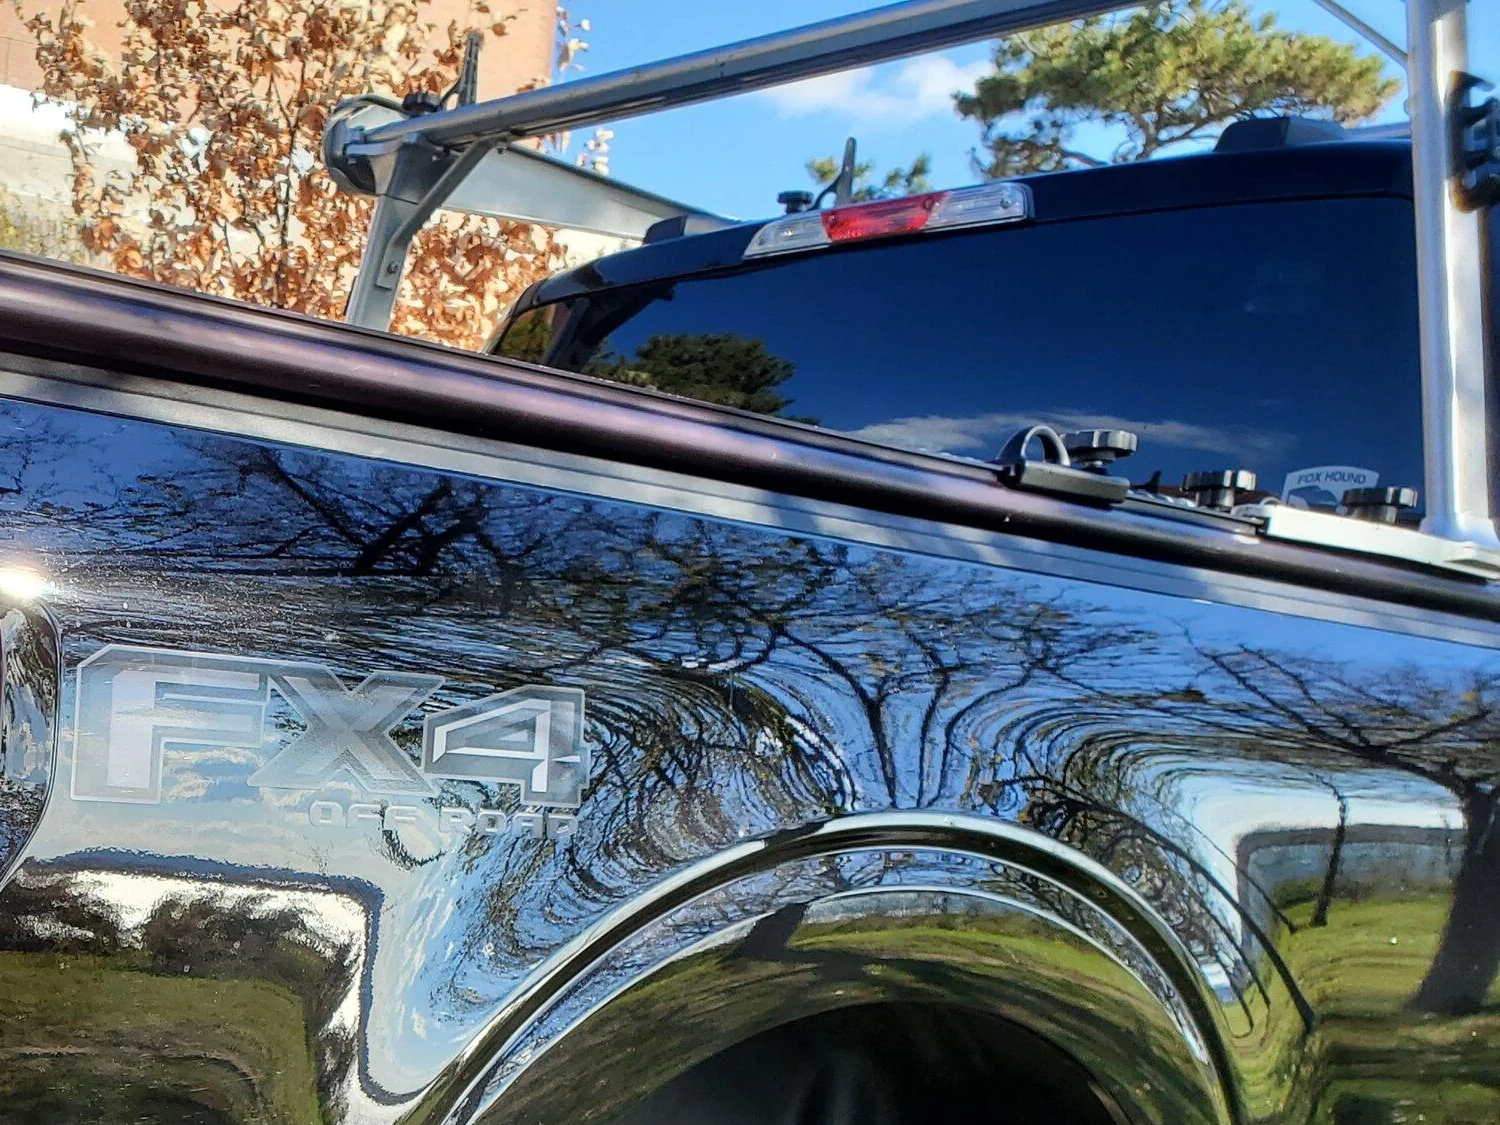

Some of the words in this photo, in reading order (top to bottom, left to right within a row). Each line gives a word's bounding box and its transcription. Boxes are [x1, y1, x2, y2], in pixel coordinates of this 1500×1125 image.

[1297, 474, 1321, 484] FOX
[1325, 472, 1366, 484] HOUND
[70, 643, 591, 808] FX4
[308, 801, 418, 832] OFF
[439, 806, 579, 840] ROAD
